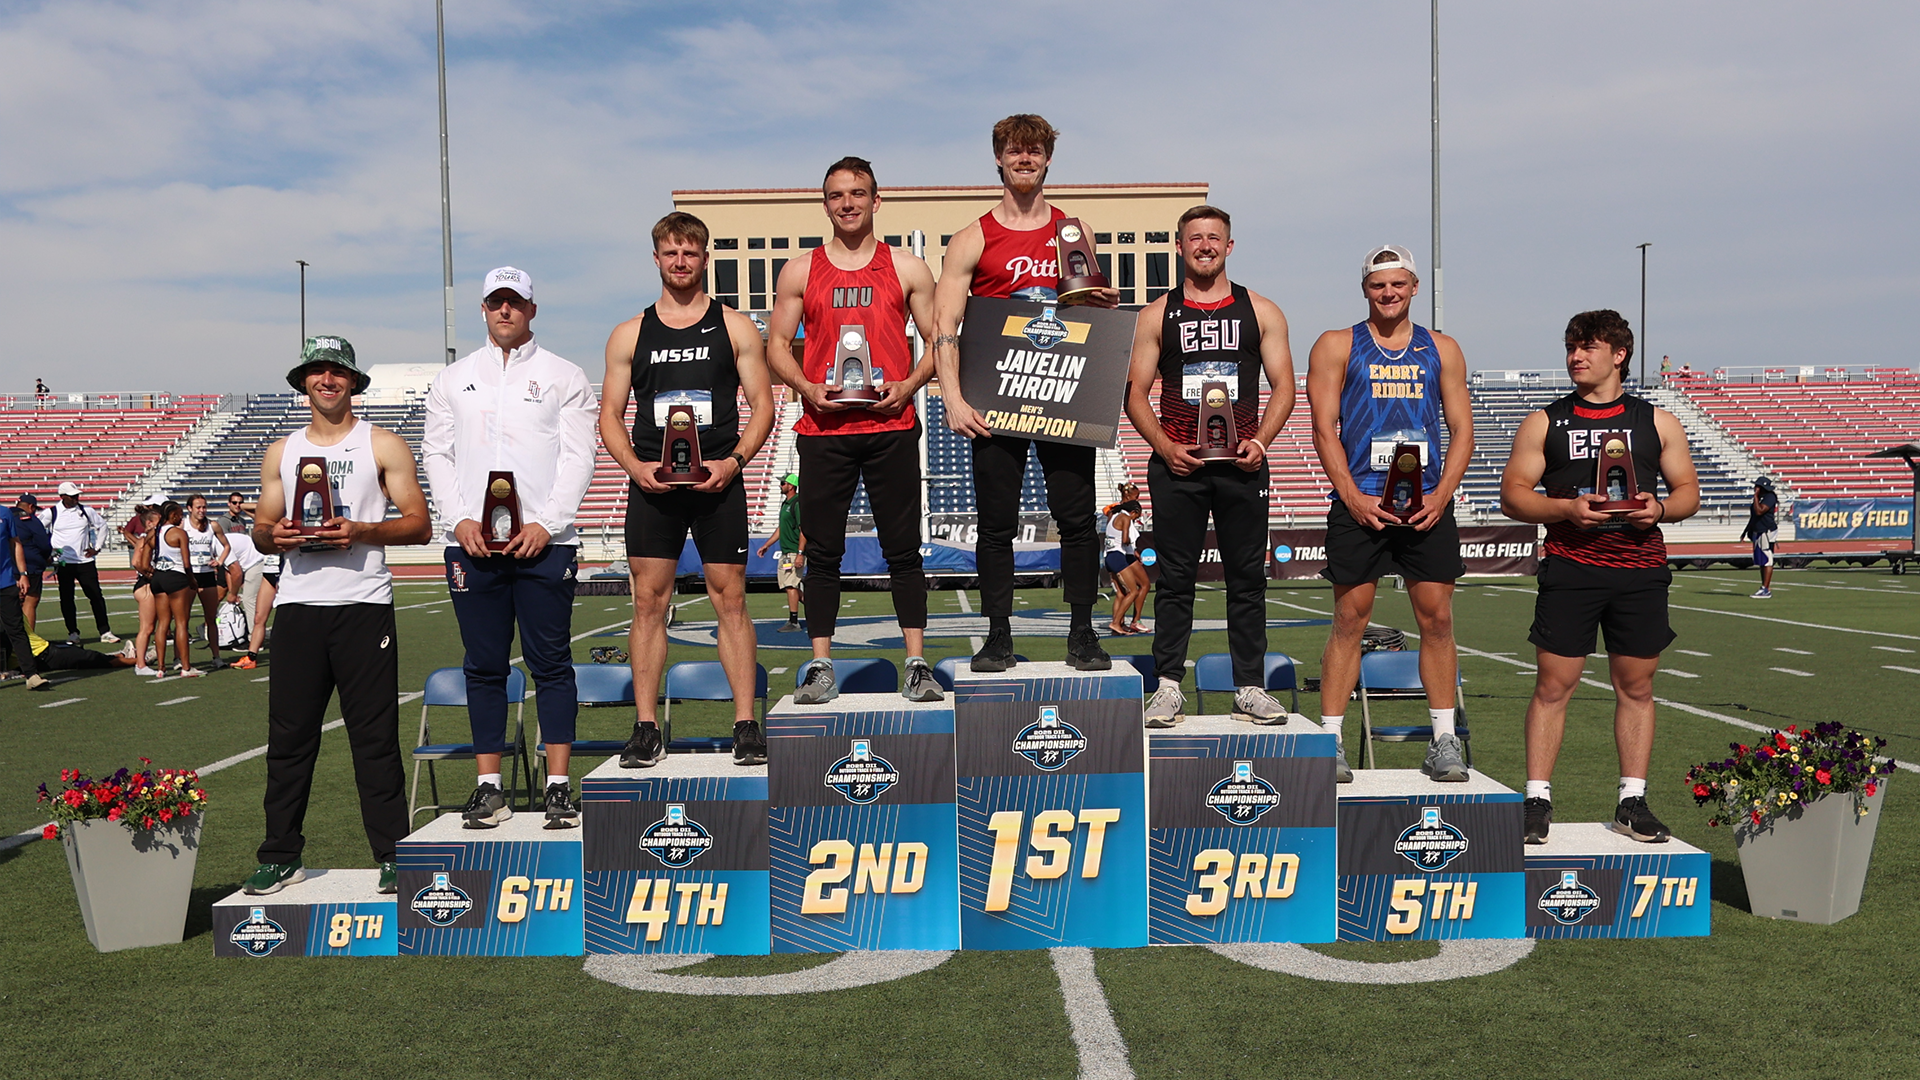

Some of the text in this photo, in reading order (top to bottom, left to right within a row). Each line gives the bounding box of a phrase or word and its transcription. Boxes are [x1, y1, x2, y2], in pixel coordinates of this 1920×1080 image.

[1005, 256, 1058, 285] Pitt
[832, 286, 873, 308] NNU
[315, 338, 342, 350] BISON
[1179, 319, 1242, 353] ESU
[996, 348, 1086, 380] JAVELIN
[1369, 364, 1426, 379] EMBRY-
[998, 373, 1079, 404] THROW
[1372, 382, 1424, 399] RIDDLE
[1020, 404, 1044, 415] MEN'S
[984, 410, 1077, 438] CHAMPION
[1798, 510, 1909, 529] TRACK & FIELD
[1294, 546, 1328, 561] TRAC
[1460, 542, 1534, 558] ACK & FIELD
[1015, 740, 1084, 750] CHAMPIONSHIPS
[828, 774, 896, 784] CHAMPIONSHIPS
[1208, 794, 1278, 804] CHAMPIONSHIPS
[642, 838, 710, 846] CHAMPIONSHIPS
[1397, 840, 1466, 850] CHAMPIONSHIPS
[984, 808, 1121, 911] 1ST
[801, 839, 929, 914] 2ND
[1184, 848, 1300, 916] 3RD
[413, 900, 470, 908] CHAMPIONSHIPS
[496, 875, 574, 924] 6TH
[1385, 878, 1478, 935] 5TH
[1630, 875, 1698, 918] 7TH
[626, 878, 728, 941] 4TH
[232, 932, 285, 941] CHAMPIONSHIPS
[328, 912, 383, 948] 8TH
